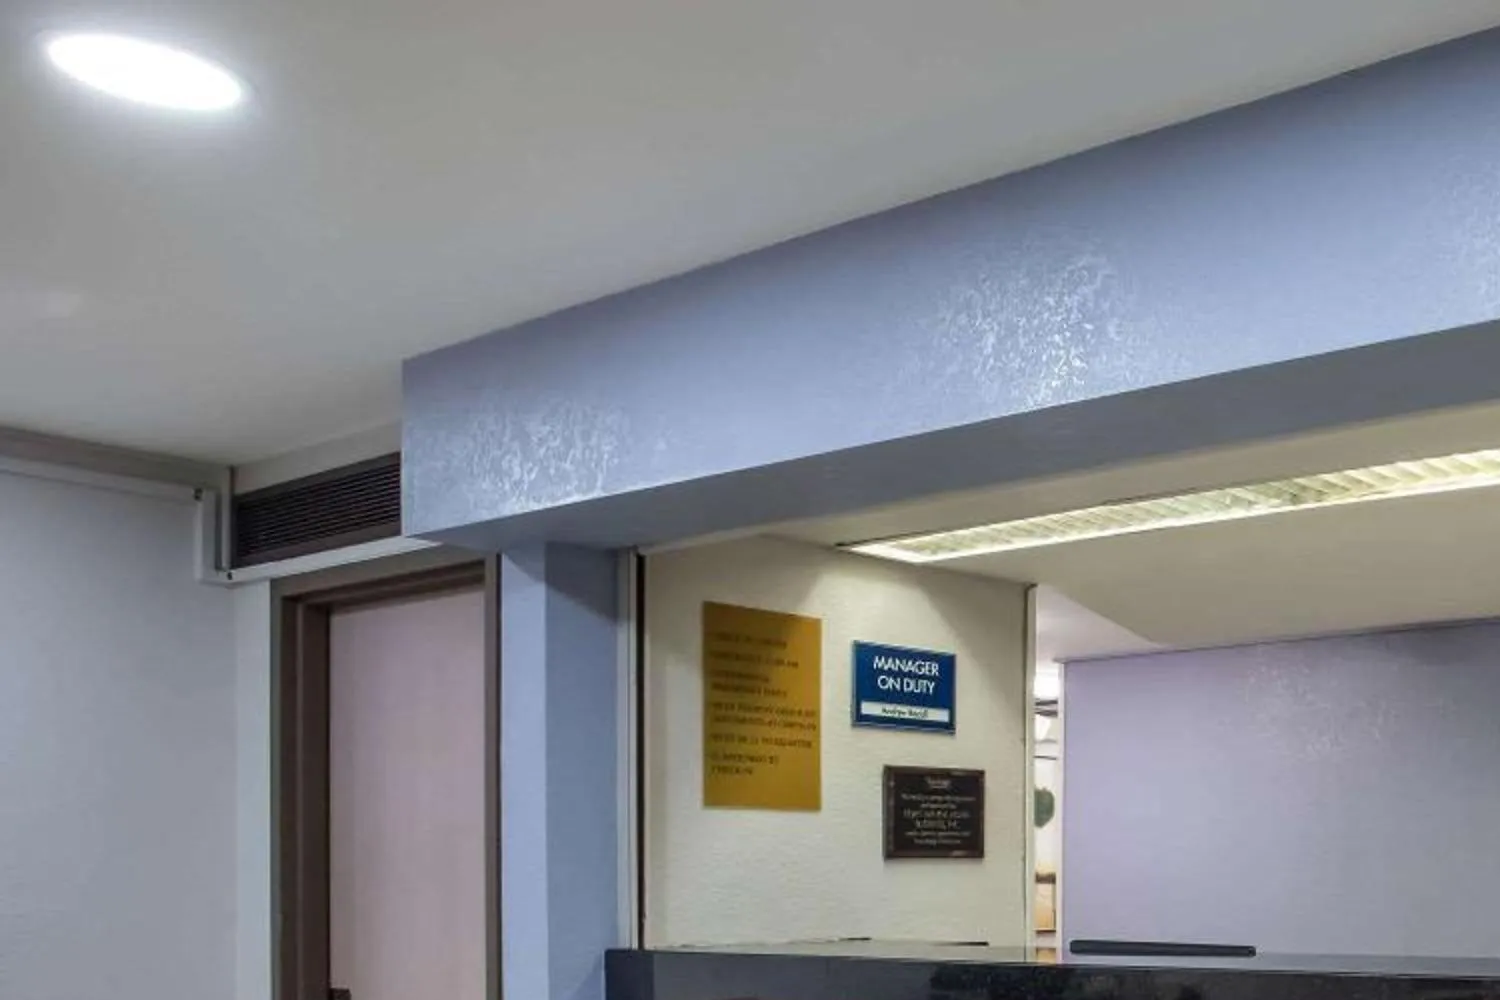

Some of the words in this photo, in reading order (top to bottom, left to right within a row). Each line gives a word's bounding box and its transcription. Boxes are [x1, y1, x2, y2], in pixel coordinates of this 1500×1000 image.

[873, 656, 939, 676] MANAGER
[878, 675, 901, 691] ON
[903, 678, 935, 695] DUTY
